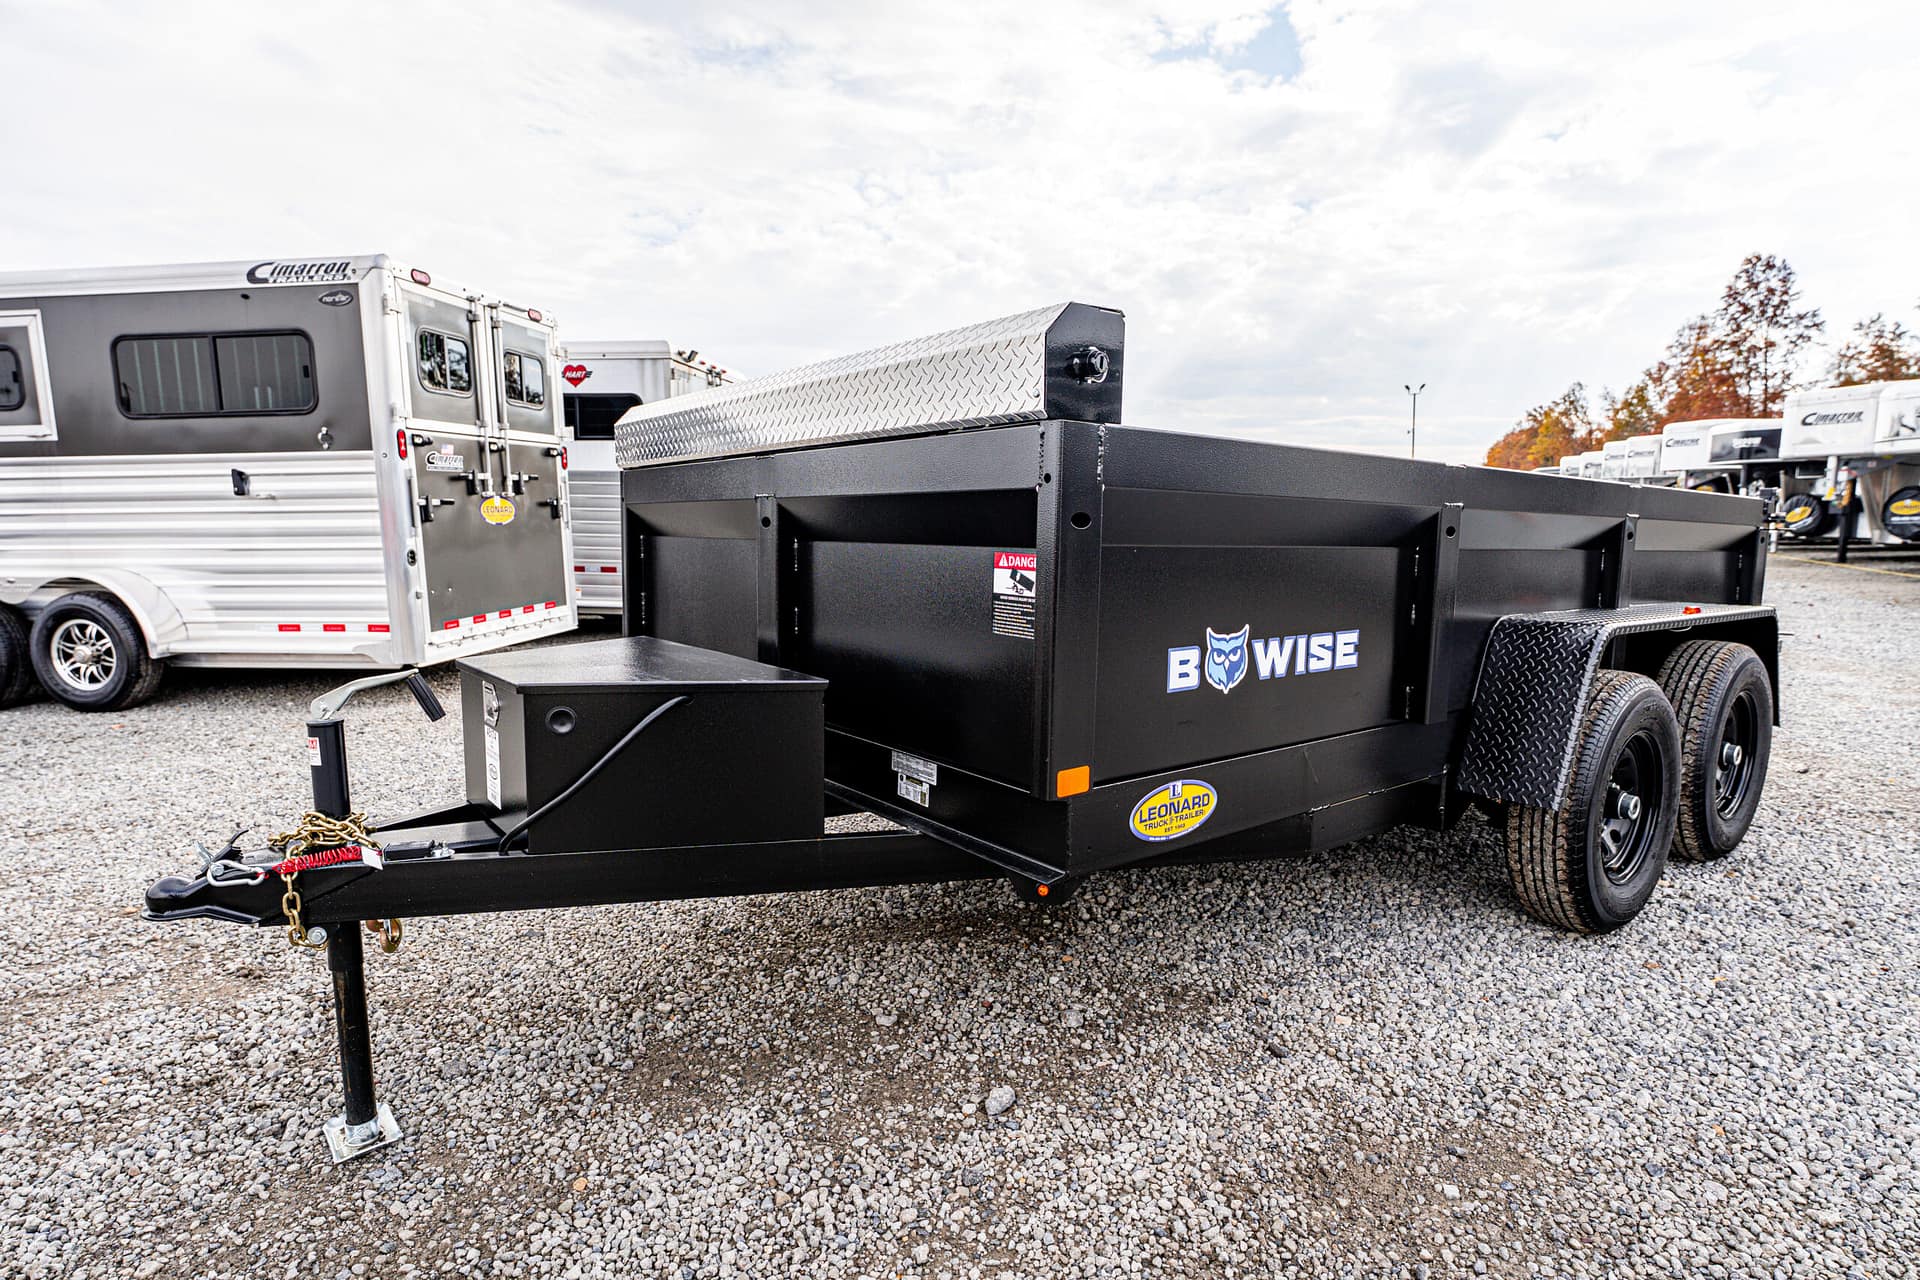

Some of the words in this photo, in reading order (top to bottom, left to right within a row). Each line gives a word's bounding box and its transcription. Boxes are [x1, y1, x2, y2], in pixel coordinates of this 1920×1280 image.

[246, 261, 351, 284] Cimarron
[565, 370, 586, 379] HART
[1008, 555, 1037, 569] DANG
[1139, 793, 1210, 824] LEONARD
[1144, 818, 1168, 832] TRUCK
[1175, 809, 1204, 823] TRAILER
